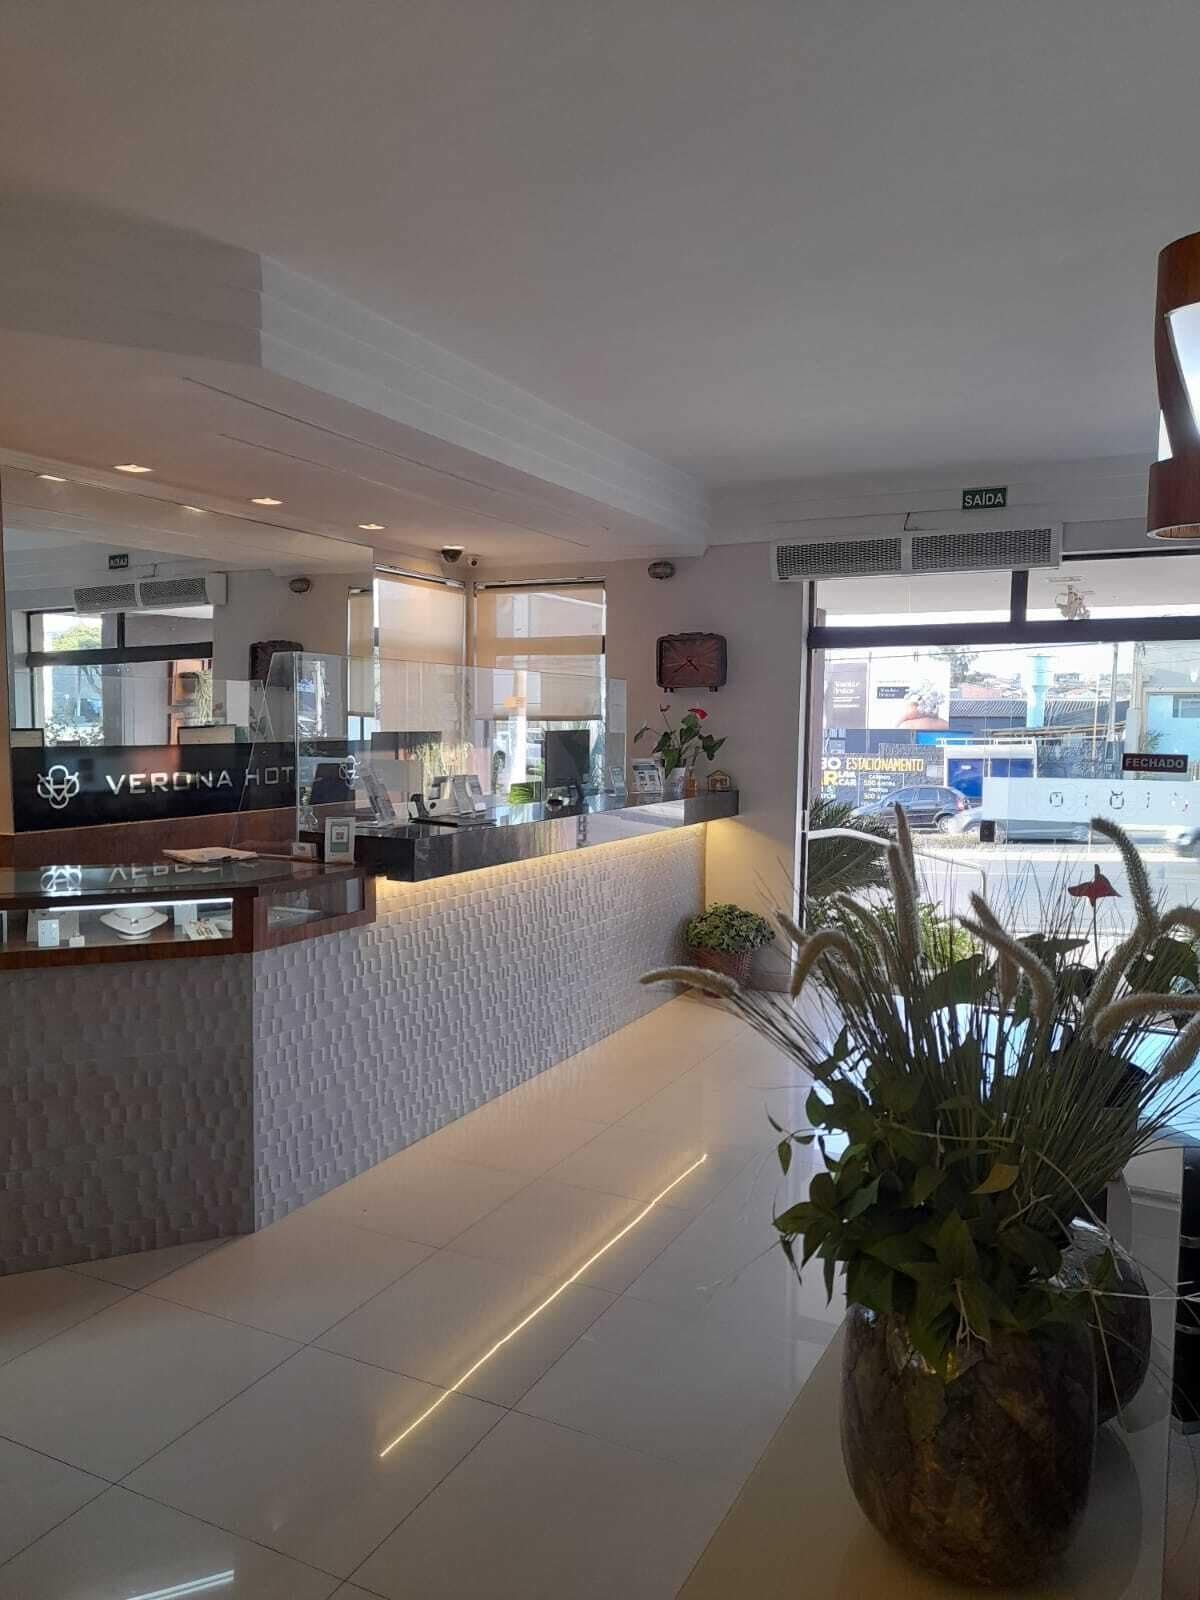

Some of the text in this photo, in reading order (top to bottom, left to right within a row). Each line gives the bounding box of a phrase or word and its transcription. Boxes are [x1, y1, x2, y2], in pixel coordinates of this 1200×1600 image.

[846, 757, 925, 772] ESTACIONAMENTO
[1125, 757, 1184, 769] FECHADO
[105, 769, 233, 795] VERONA
